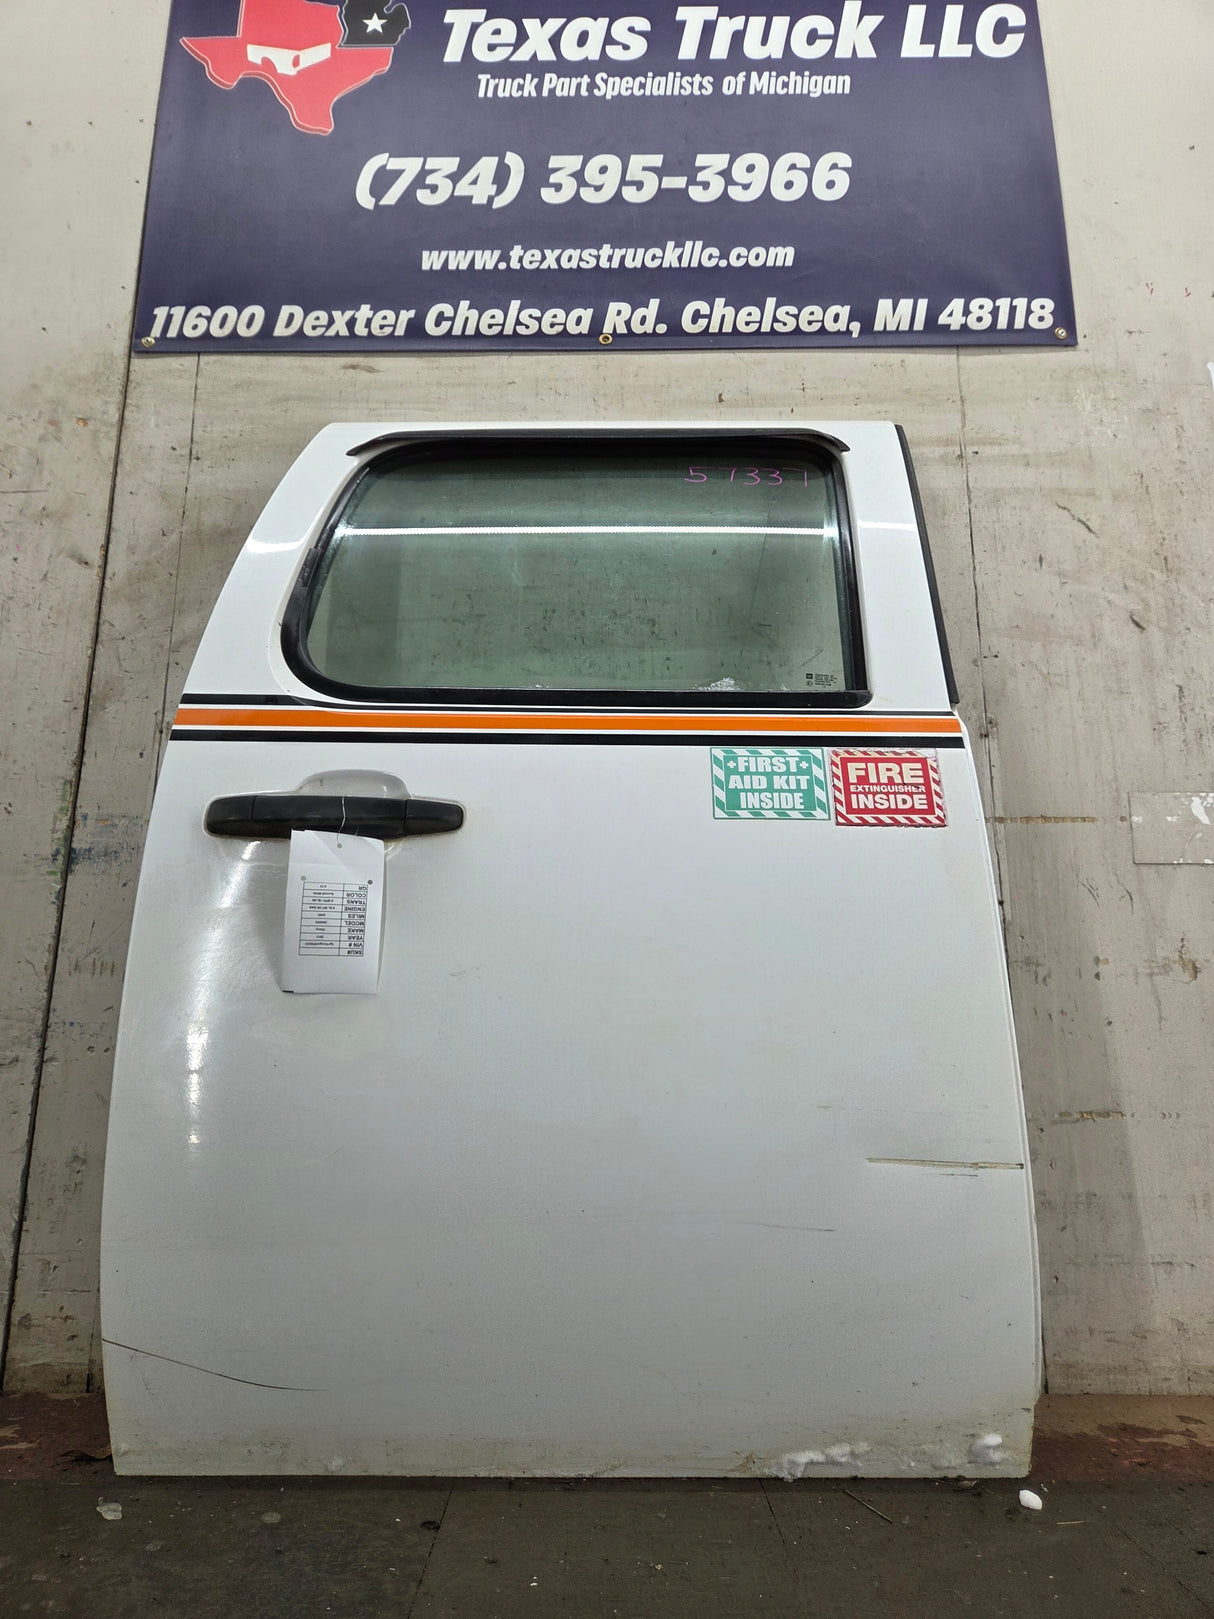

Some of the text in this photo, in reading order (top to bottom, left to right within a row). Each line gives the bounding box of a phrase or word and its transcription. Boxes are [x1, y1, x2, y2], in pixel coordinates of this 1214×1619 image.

[443, 0, 1027, 63] Texas Truck LLC
[478, 71, 852, 101] Truck Part Specialists of Michigan
[356, 151, 853, 210] (734) 395-3966
[421, 241, 796, 271] www.texastruckllc.com
[151, 296, 1055, 339] 11600 Dexter Chelsea Rd. Chelsea, MI 48118
[737, 757, 800, 773] FIRST
[847, 762, 924, 784] FIRE
[728, 775, 810, 790] AID KIT
[849, 784, 926, 793] EXTINGUISHER
[739, 792, 805, 809] INSIDE
[849, 793, 929, 810] INSIDE
